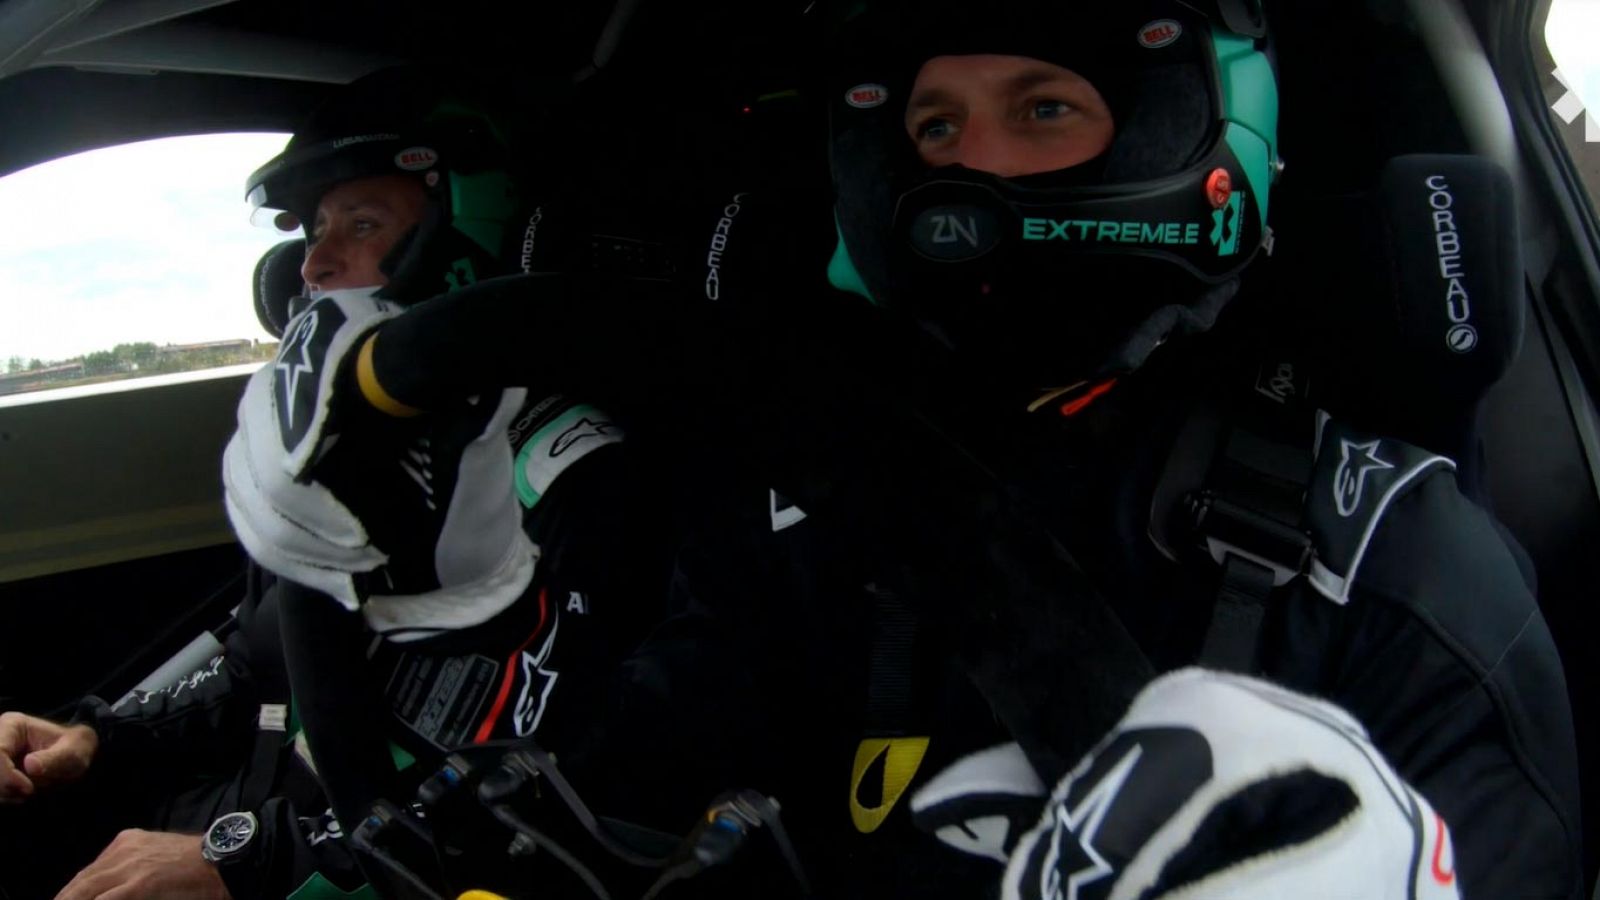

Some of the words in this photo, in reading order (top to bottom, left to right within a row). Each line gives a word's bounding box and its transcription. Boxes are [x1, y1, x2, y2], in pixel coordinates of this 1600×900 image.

[1144, 26, 1174, 42] BELL
[852, 90, 880, 102] BELL
[401, 152, 433, 164] BELL
[705, 191, 752, 301] CORBEAU
[1425, 175, 1471, 324] CORBEAU
